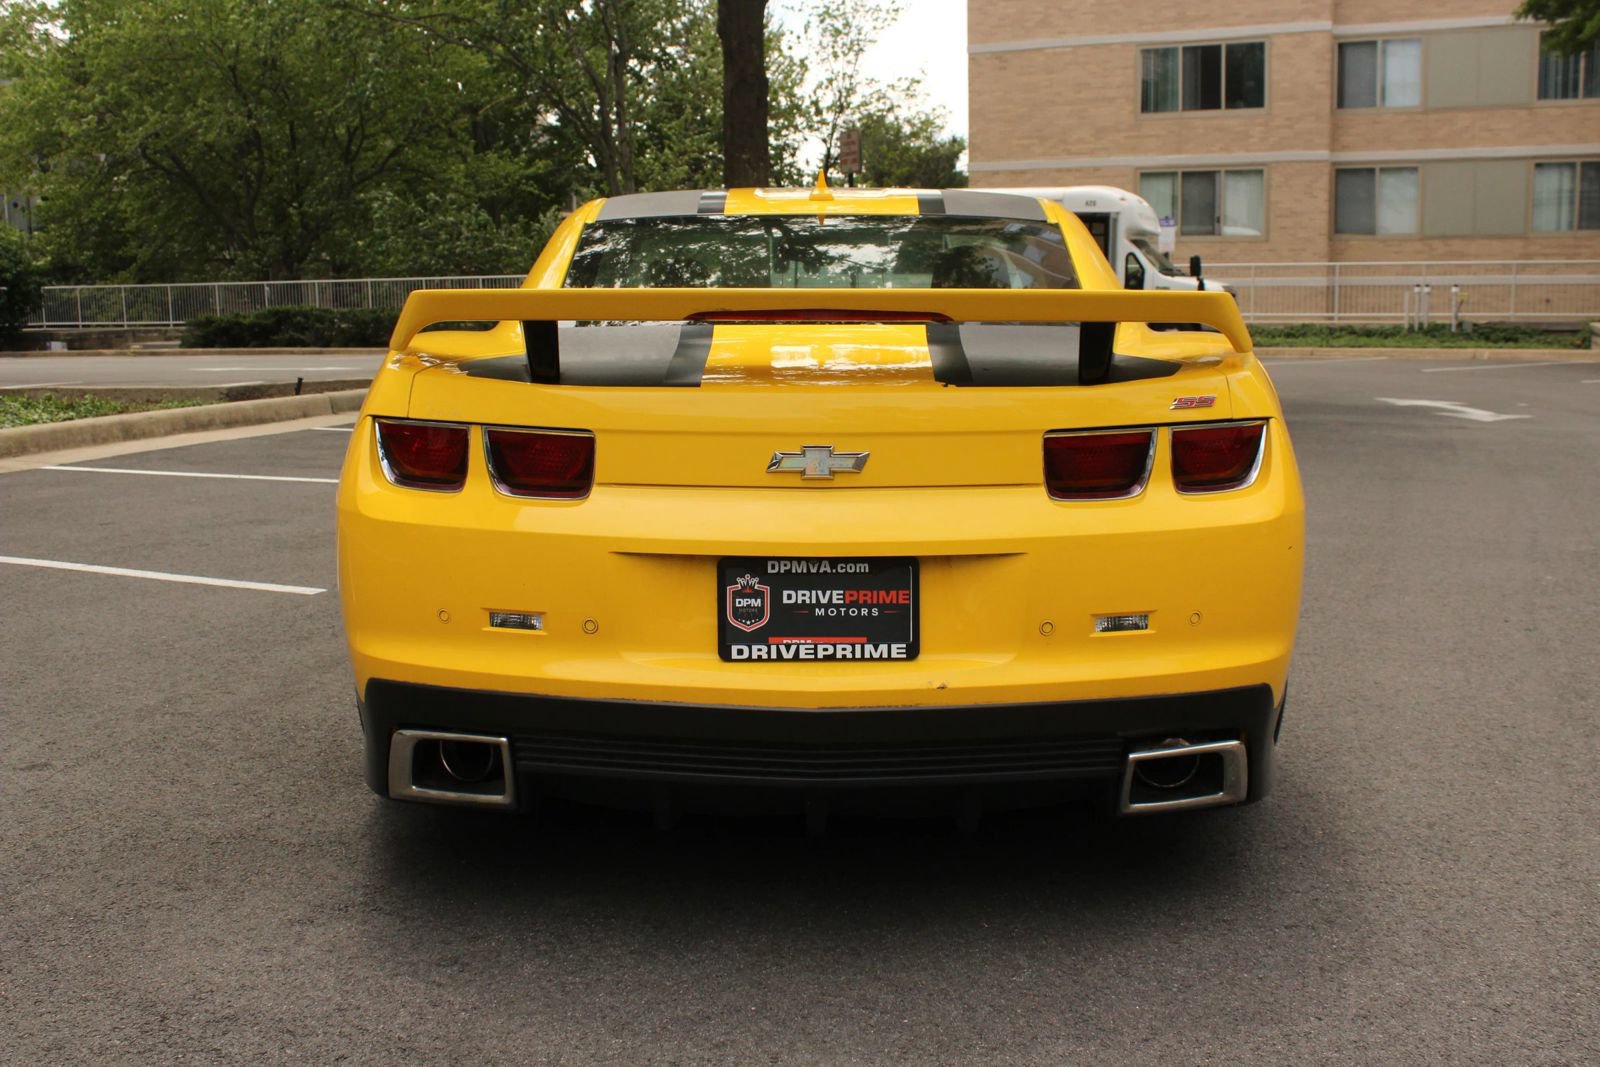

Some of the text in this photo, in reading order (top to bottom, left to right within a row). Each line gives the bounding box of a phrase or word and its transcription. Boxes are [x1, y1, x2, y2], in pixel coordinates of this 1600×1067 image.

[735, 598, 762, 608] DPM
[815, 608, 879, 617] MOTORS
[731, 644, 907, 660] DRIVEPRIME
